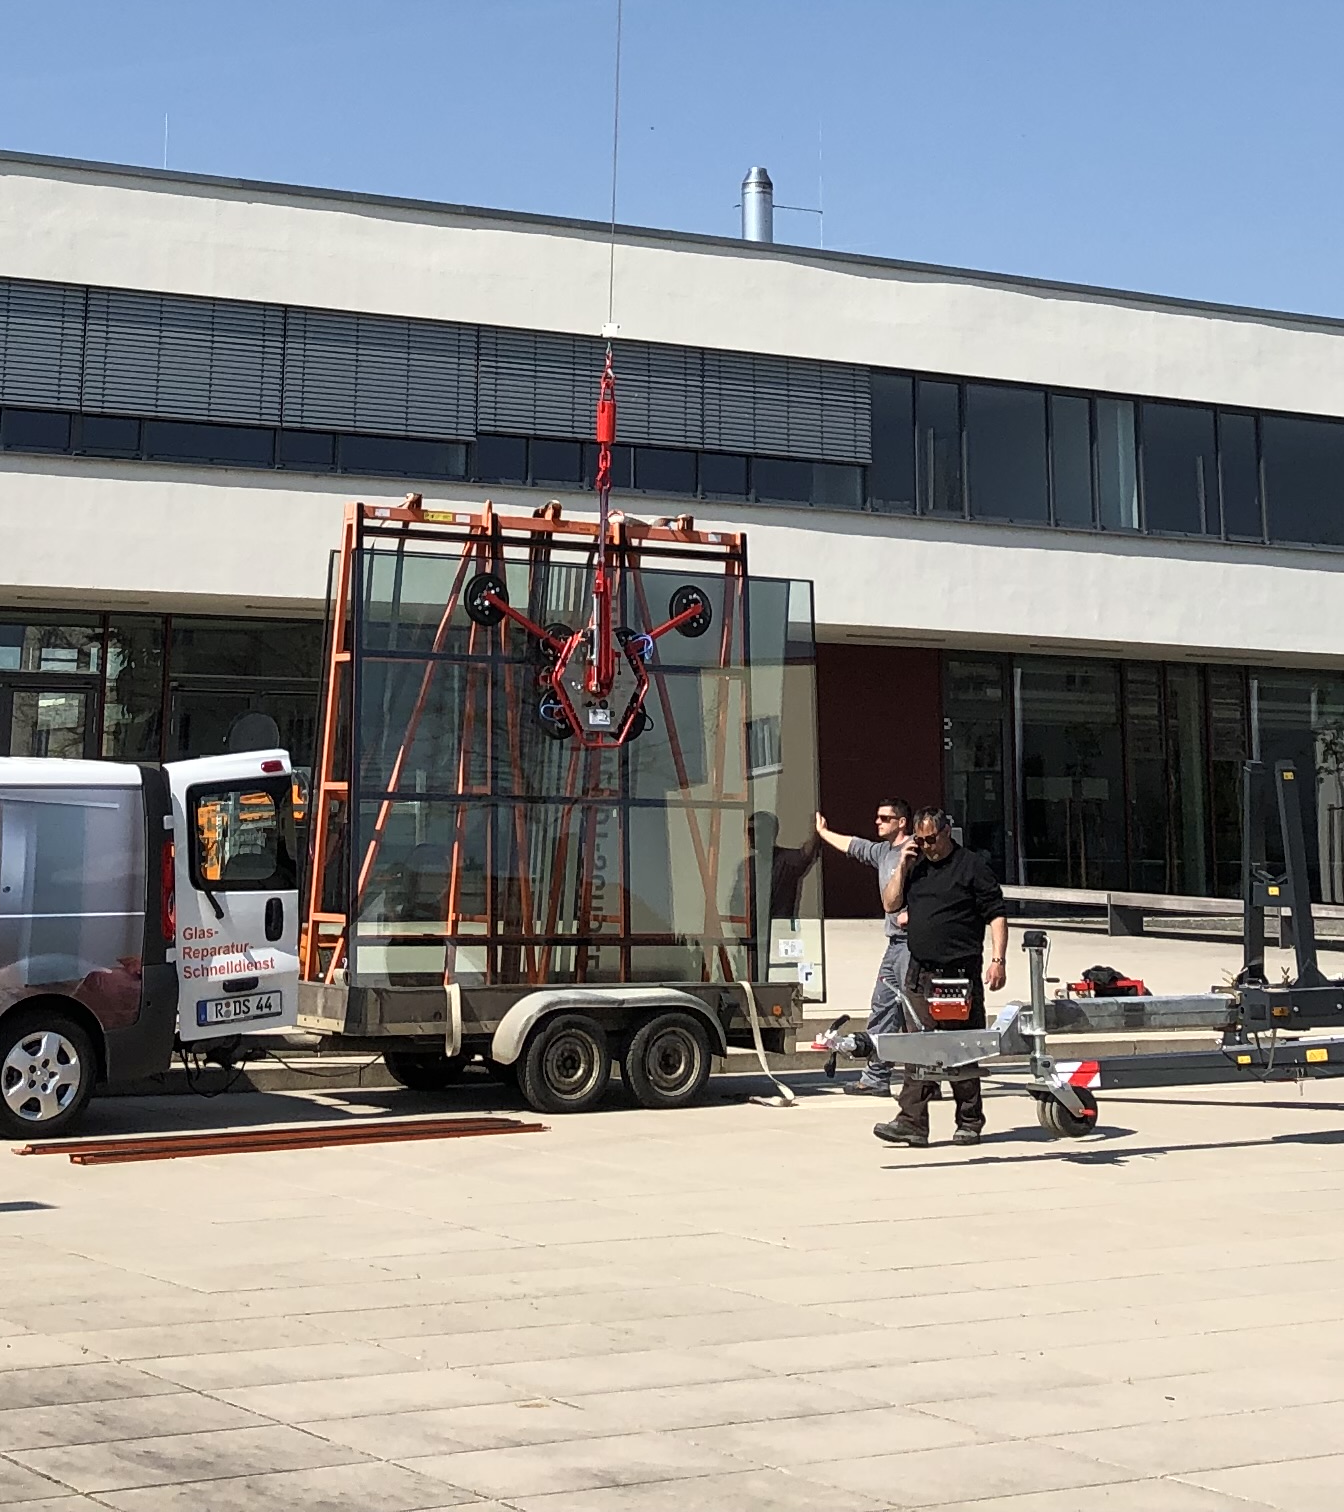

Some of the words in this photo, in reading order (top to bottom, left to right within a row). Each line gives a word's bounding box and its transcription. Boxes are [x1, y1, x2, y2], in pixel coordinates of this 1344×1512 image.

[183, 927, 219, 941] Glas-
[182, 942, 254, 961] Reparatur-
[183, 957, 275, 979] Schnelldienst
[215, 1003, 224, 1019] R
[233, 999, 251, 1016] DS
[256, 996, 273, 1012] 44
